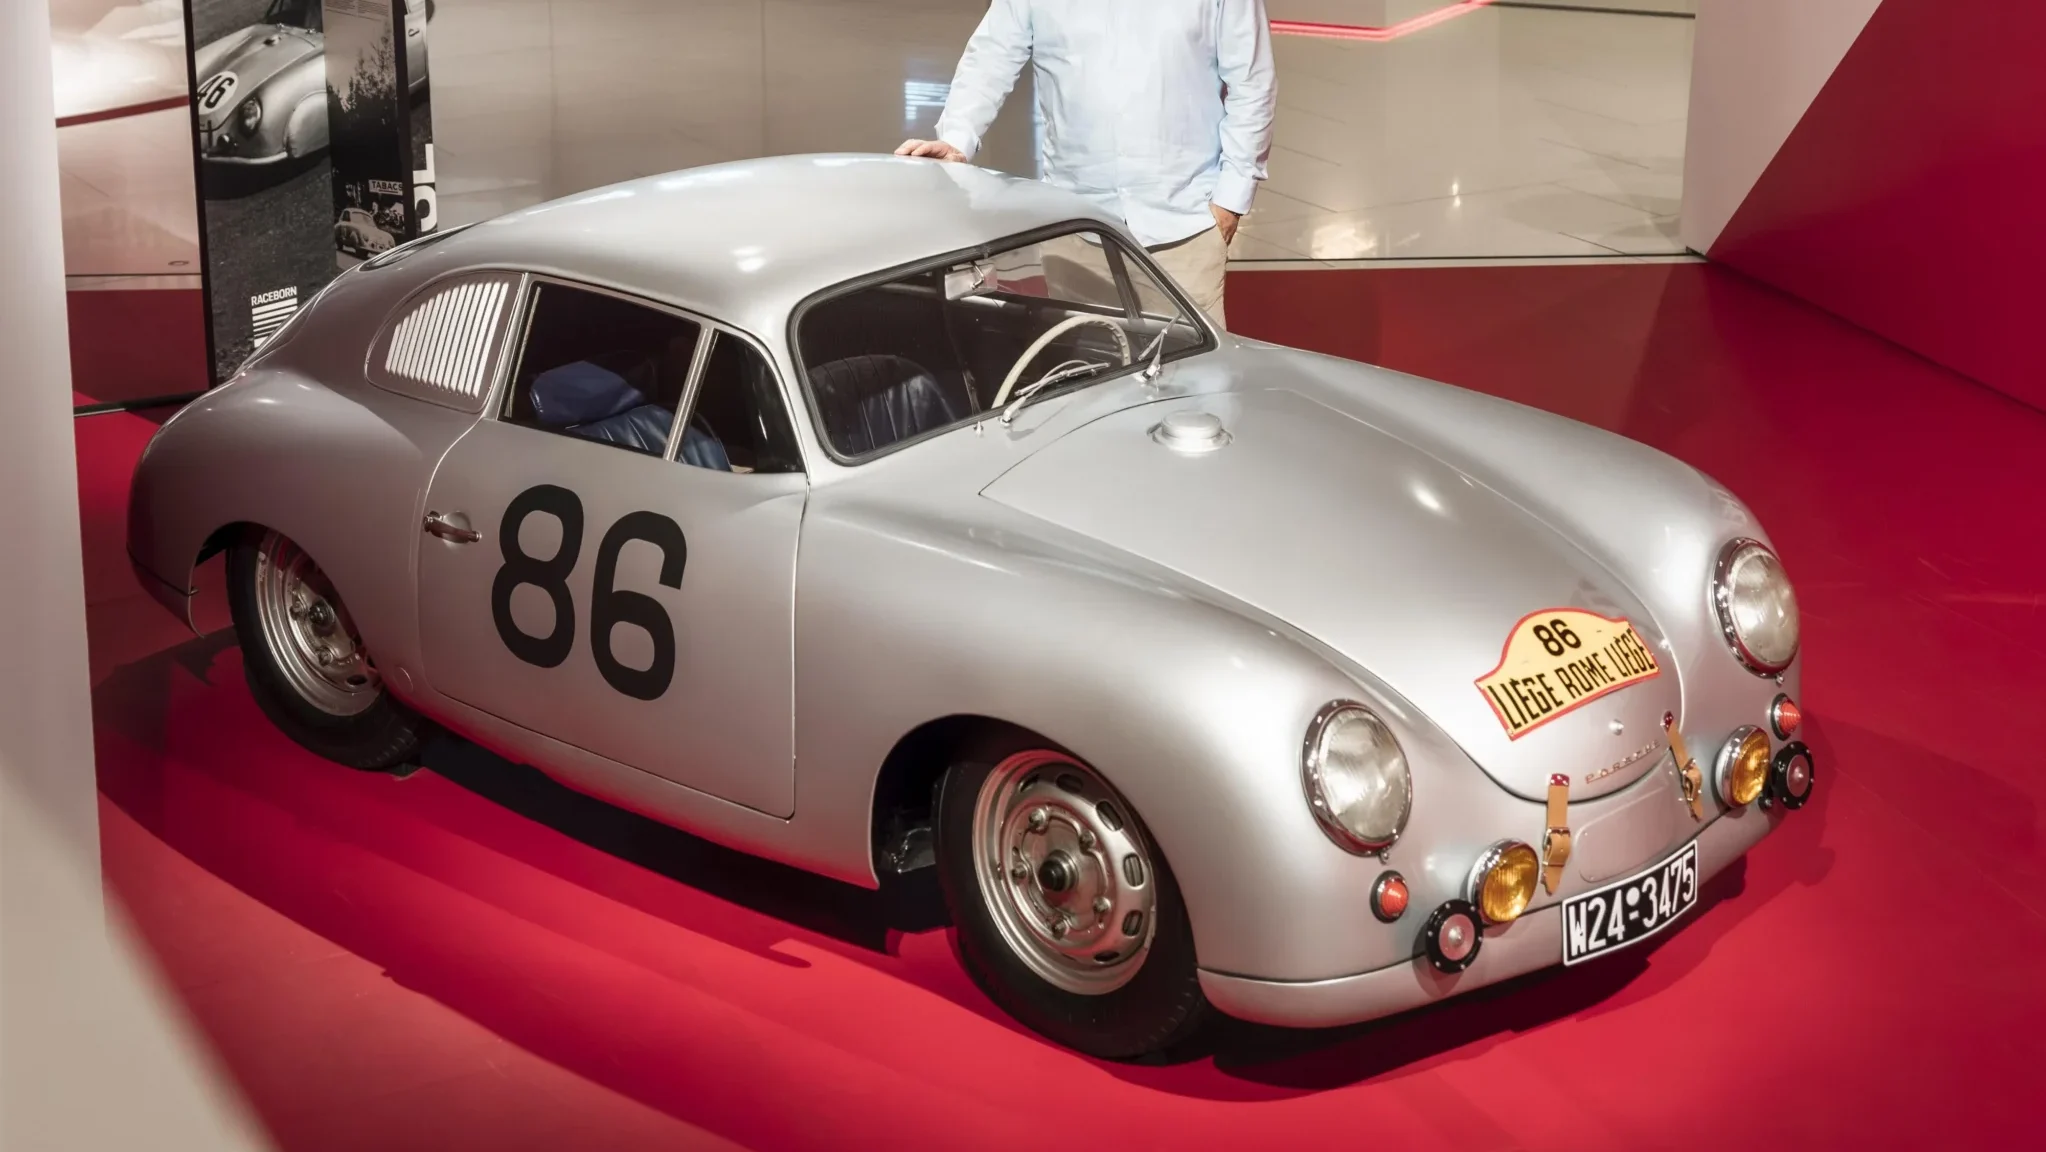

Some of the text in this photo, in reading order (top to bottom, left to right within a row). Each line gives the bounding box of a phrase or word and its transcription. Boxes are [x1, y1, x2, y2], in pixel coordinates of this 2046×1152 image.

[198, 74, 235, 109] 46
[251, 285, 298, 307] RACEBORN
[491, 484, 687, 701] 86
[1532, 618, 1582, 657] 86
[1554, 652, 1616, 699] ROME
